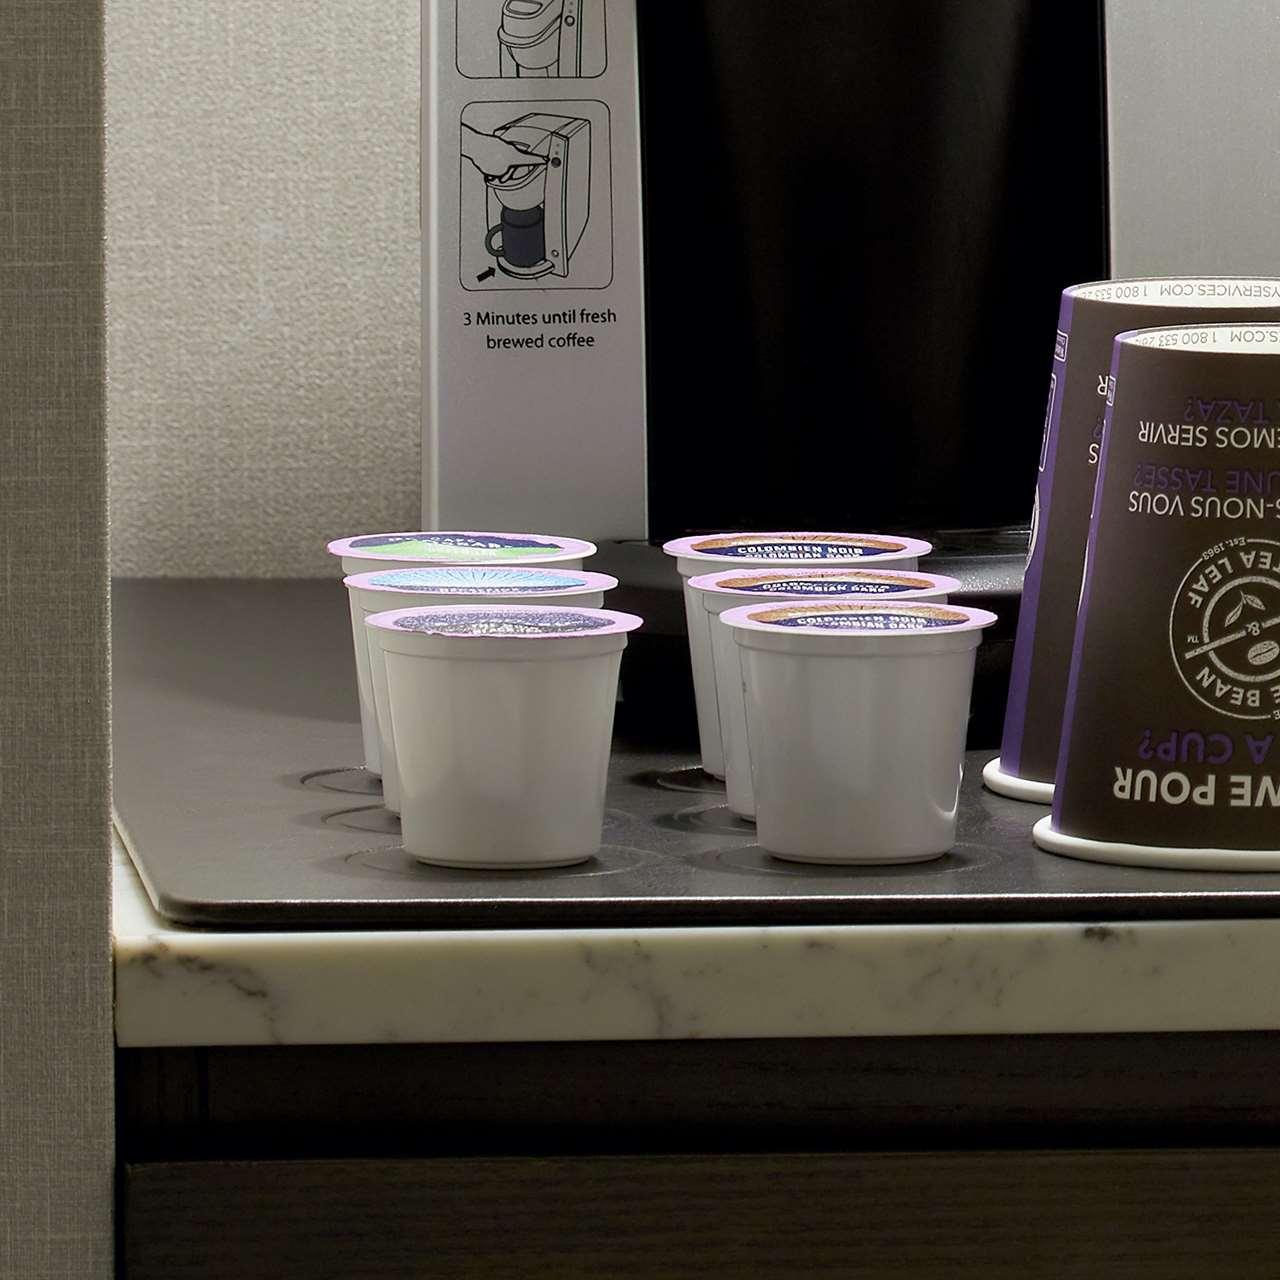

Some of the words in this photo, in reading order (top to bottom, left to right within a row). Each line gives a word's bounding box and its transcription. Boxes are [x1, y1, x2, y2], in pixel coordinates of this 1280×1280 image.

[1115, 285, 1139, 299] 800
[463, 311, 472, 326] 3
[476, 311, 538, 326] Minutes
[541, 309, 578, 325] until
[580, 308, 617, 324] fresh
[486, 333, 544, 350] brewed
[547, 331, 595, 348] coffee
[1158, 333, 1179, 347] 533
[1181, 331, 1208, 344] 800
[1183, 399, 1267, 422] TAZA?
[1138, 420, 1208, 446] SERVIR
[1133, 464, 1216, 492] TASSE?
[1128, 490, 1184, 516] VOUS
[1202, 543, 1224, 561] 1963
[1225, 537, 1246, 552] Est.
[1186, 557, 1233, 608] LEAF
[1247, 621, 1260, 635] &
[1196, 666, 1260, 707] BEAN
[1138, 728, 1236, 763] CUP?
[1247, 730, 1275, 761] A
[1113, 766, 1217, 807] POUR
